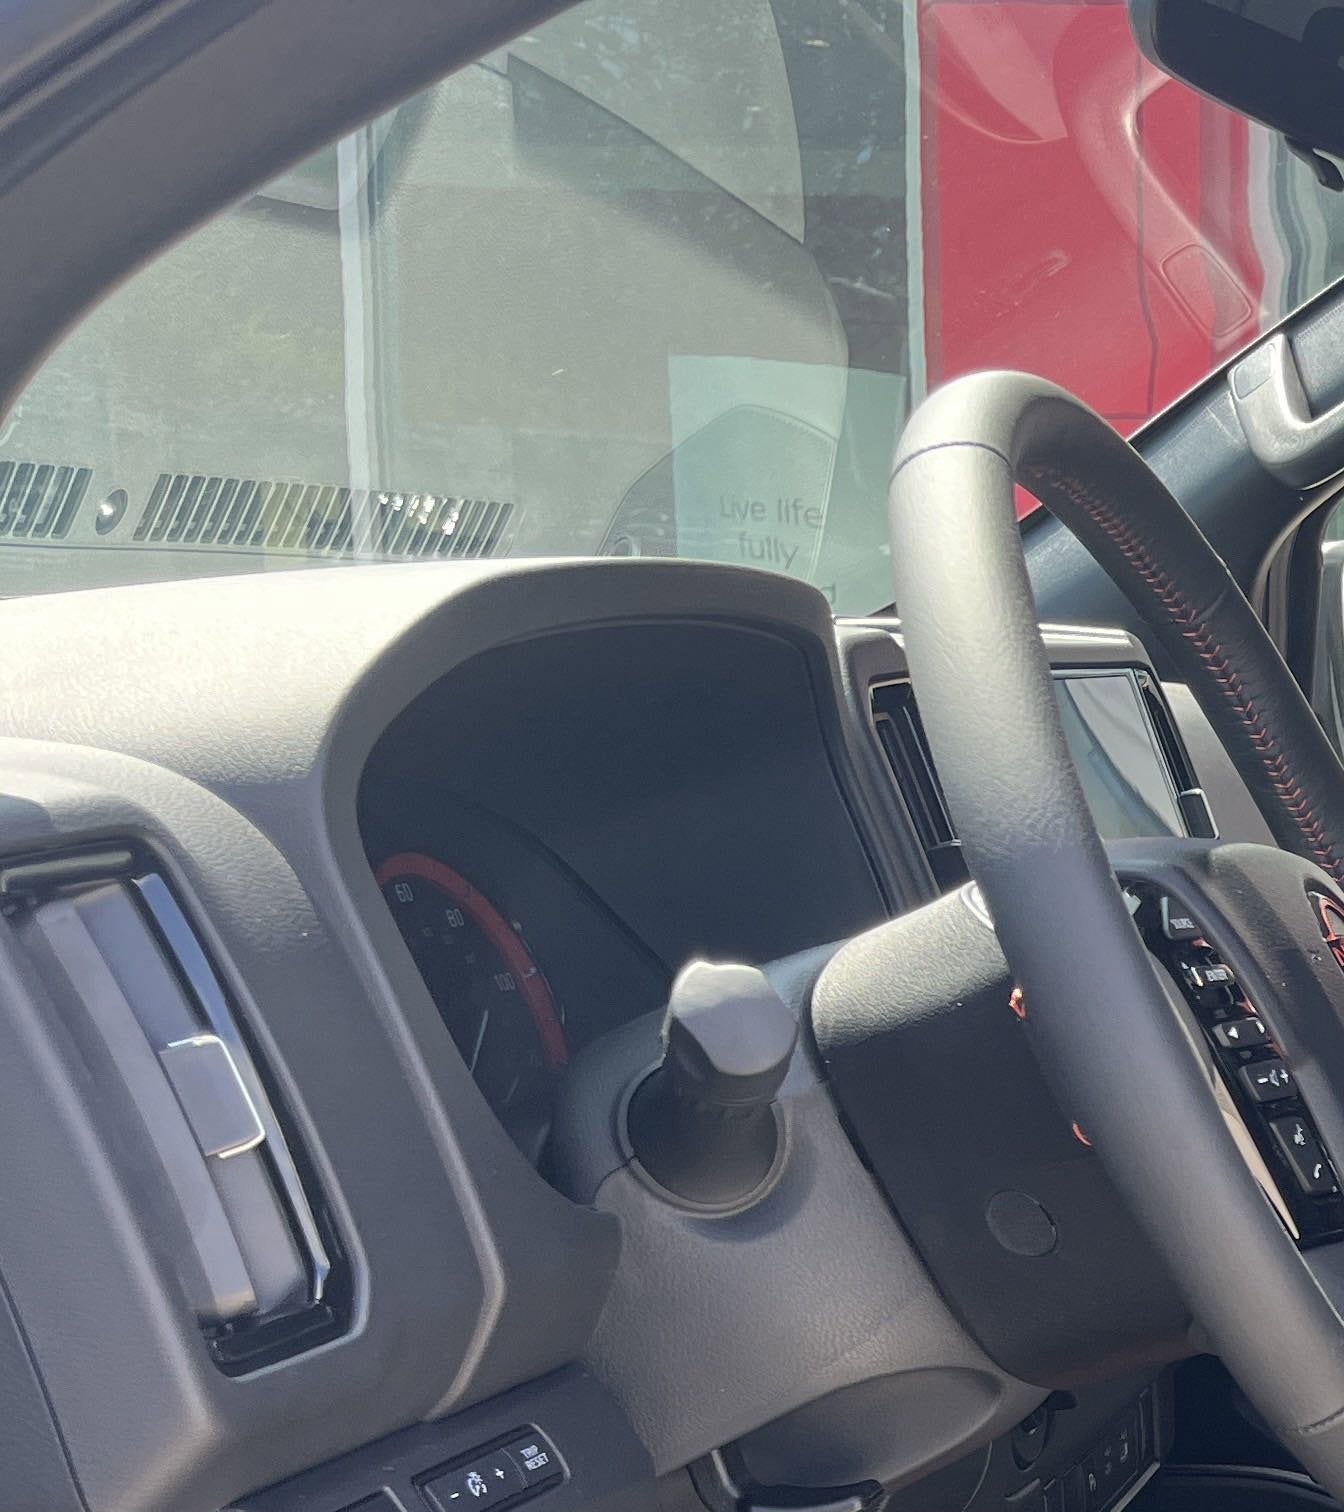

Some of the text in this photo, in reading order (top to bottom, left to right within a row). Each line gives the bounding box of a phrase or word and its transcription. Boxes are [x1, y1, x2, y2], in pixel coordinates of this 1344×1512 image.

[776, 497, 824, 530] life
[738, 530, 799, 570] fully
[524, 1452, 549, 1471] RESET
